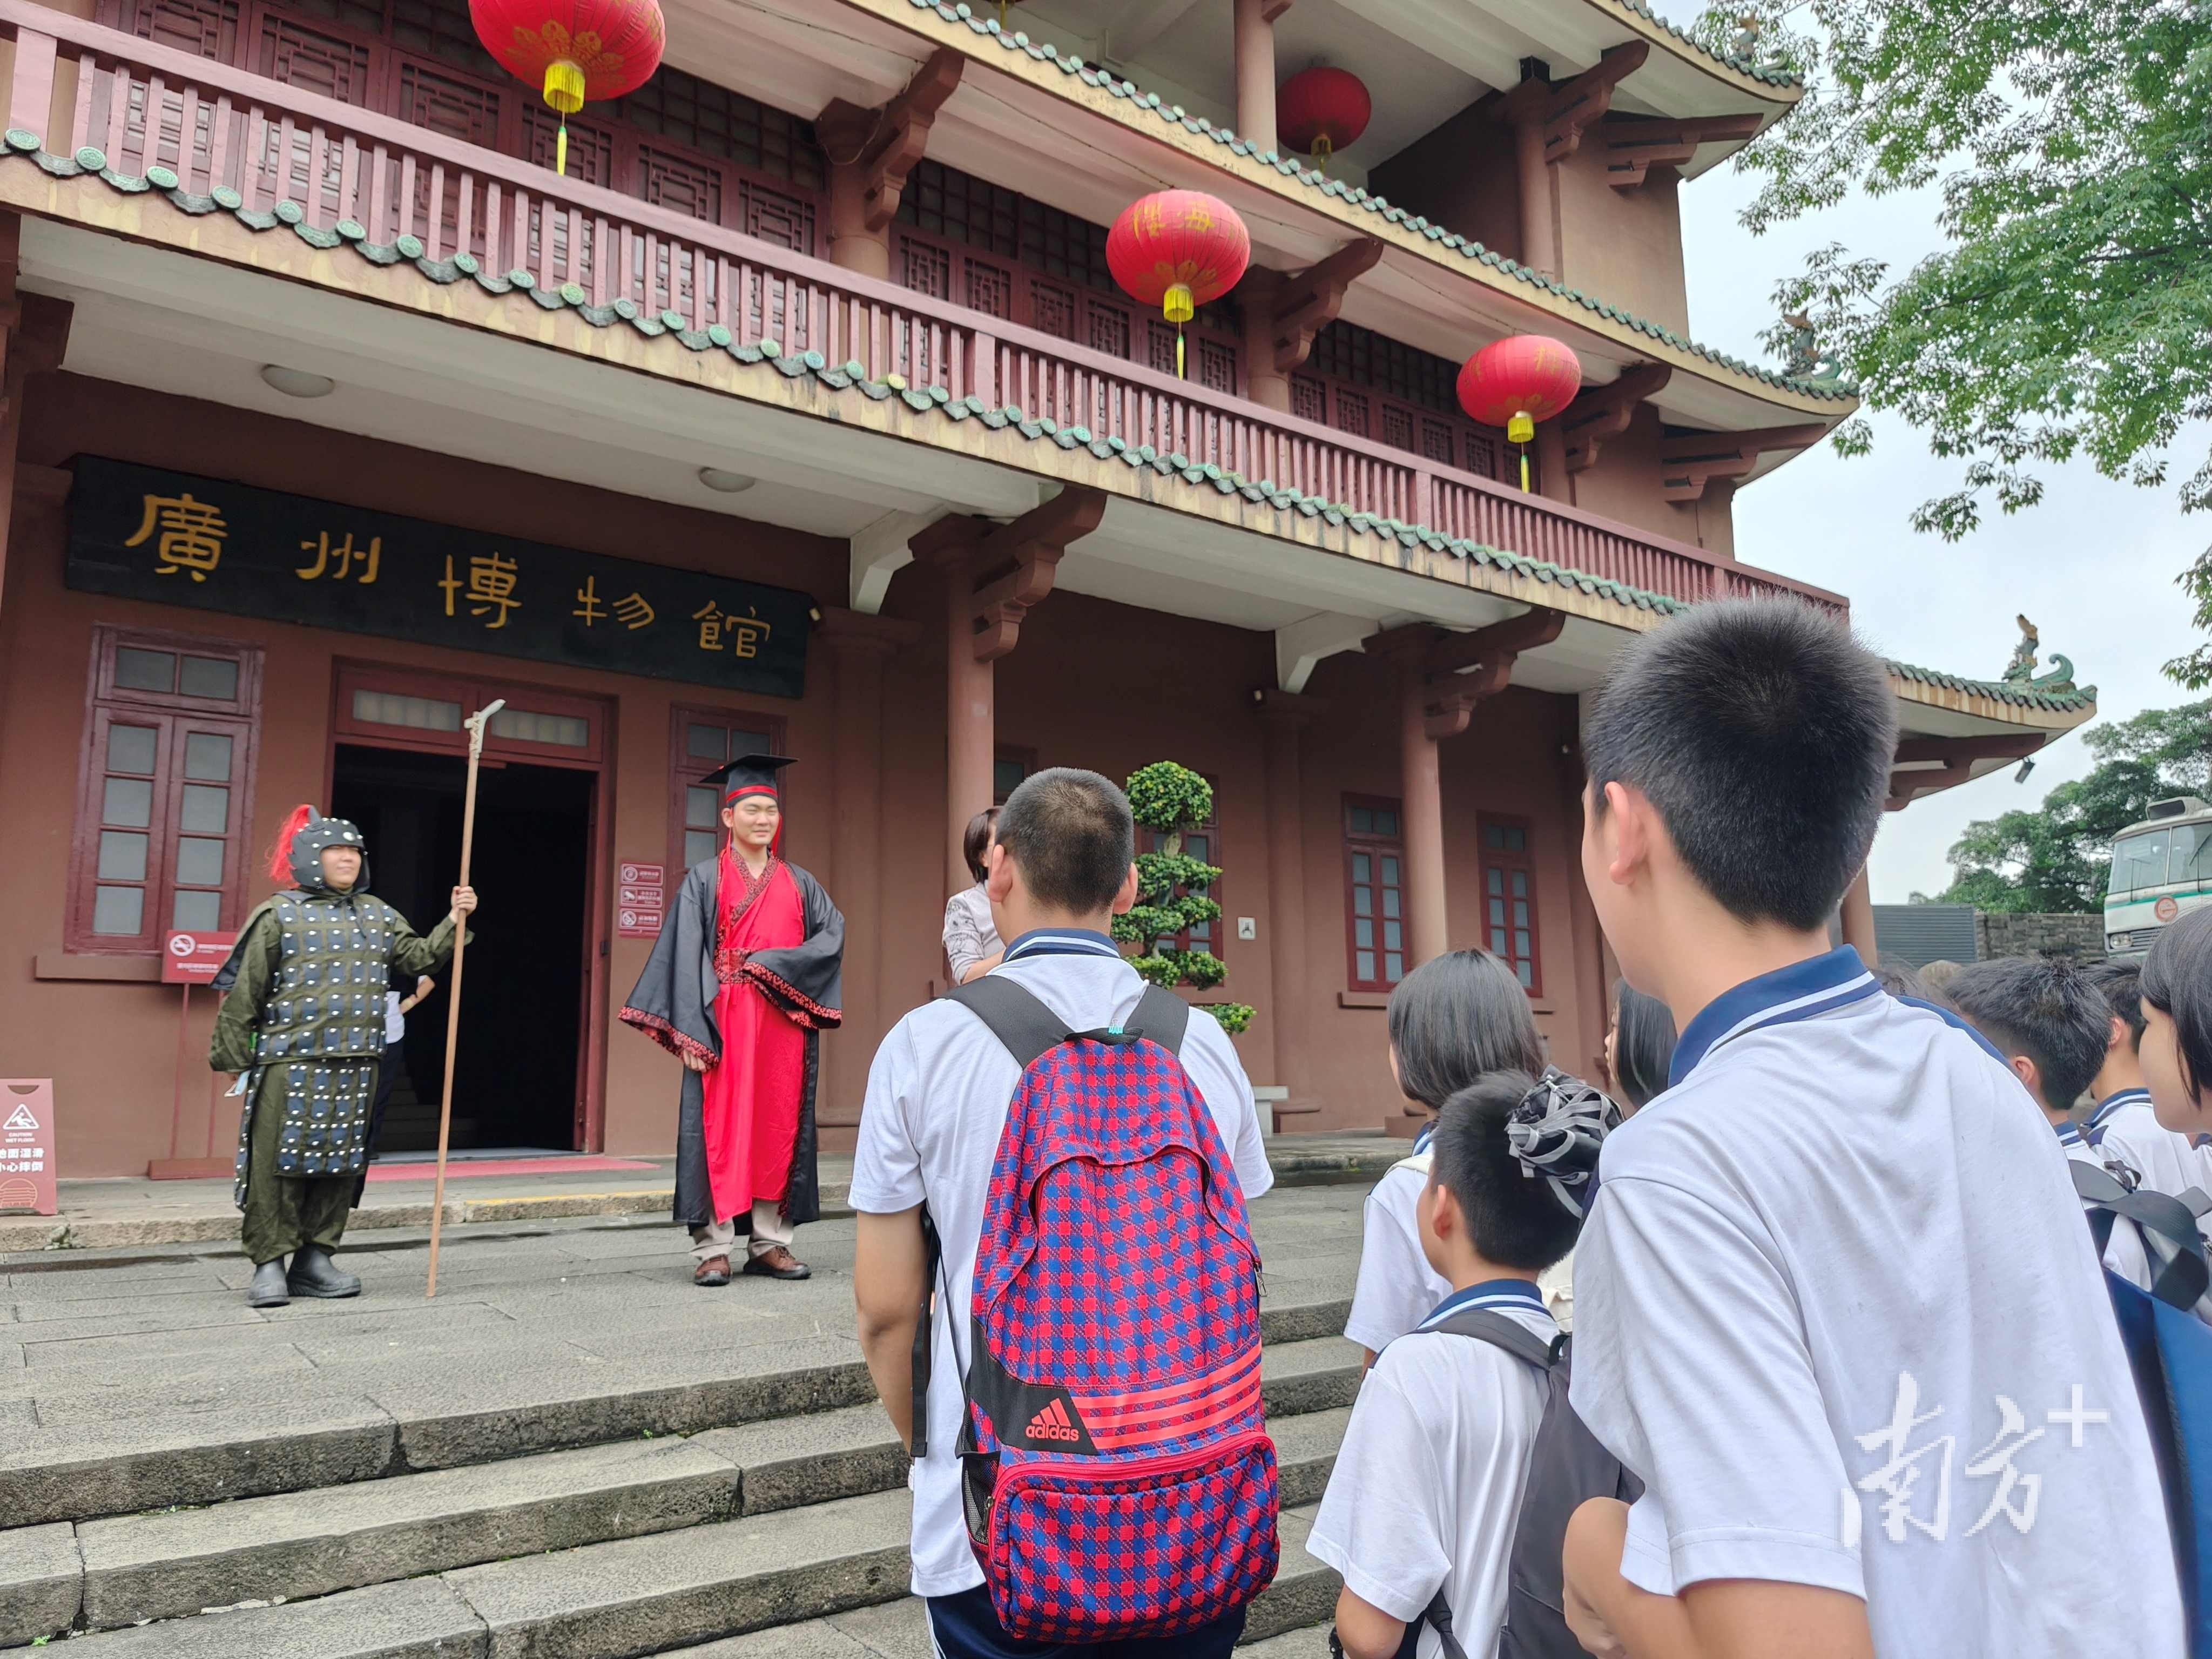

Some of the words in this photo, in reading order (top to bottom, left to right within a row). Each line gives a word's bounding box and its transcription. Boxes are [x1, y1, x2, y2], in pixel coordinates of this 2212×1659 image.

[125, 494, 771, 658] 廣州博物館
[1026, 1424, 1079, 1441] adidas
